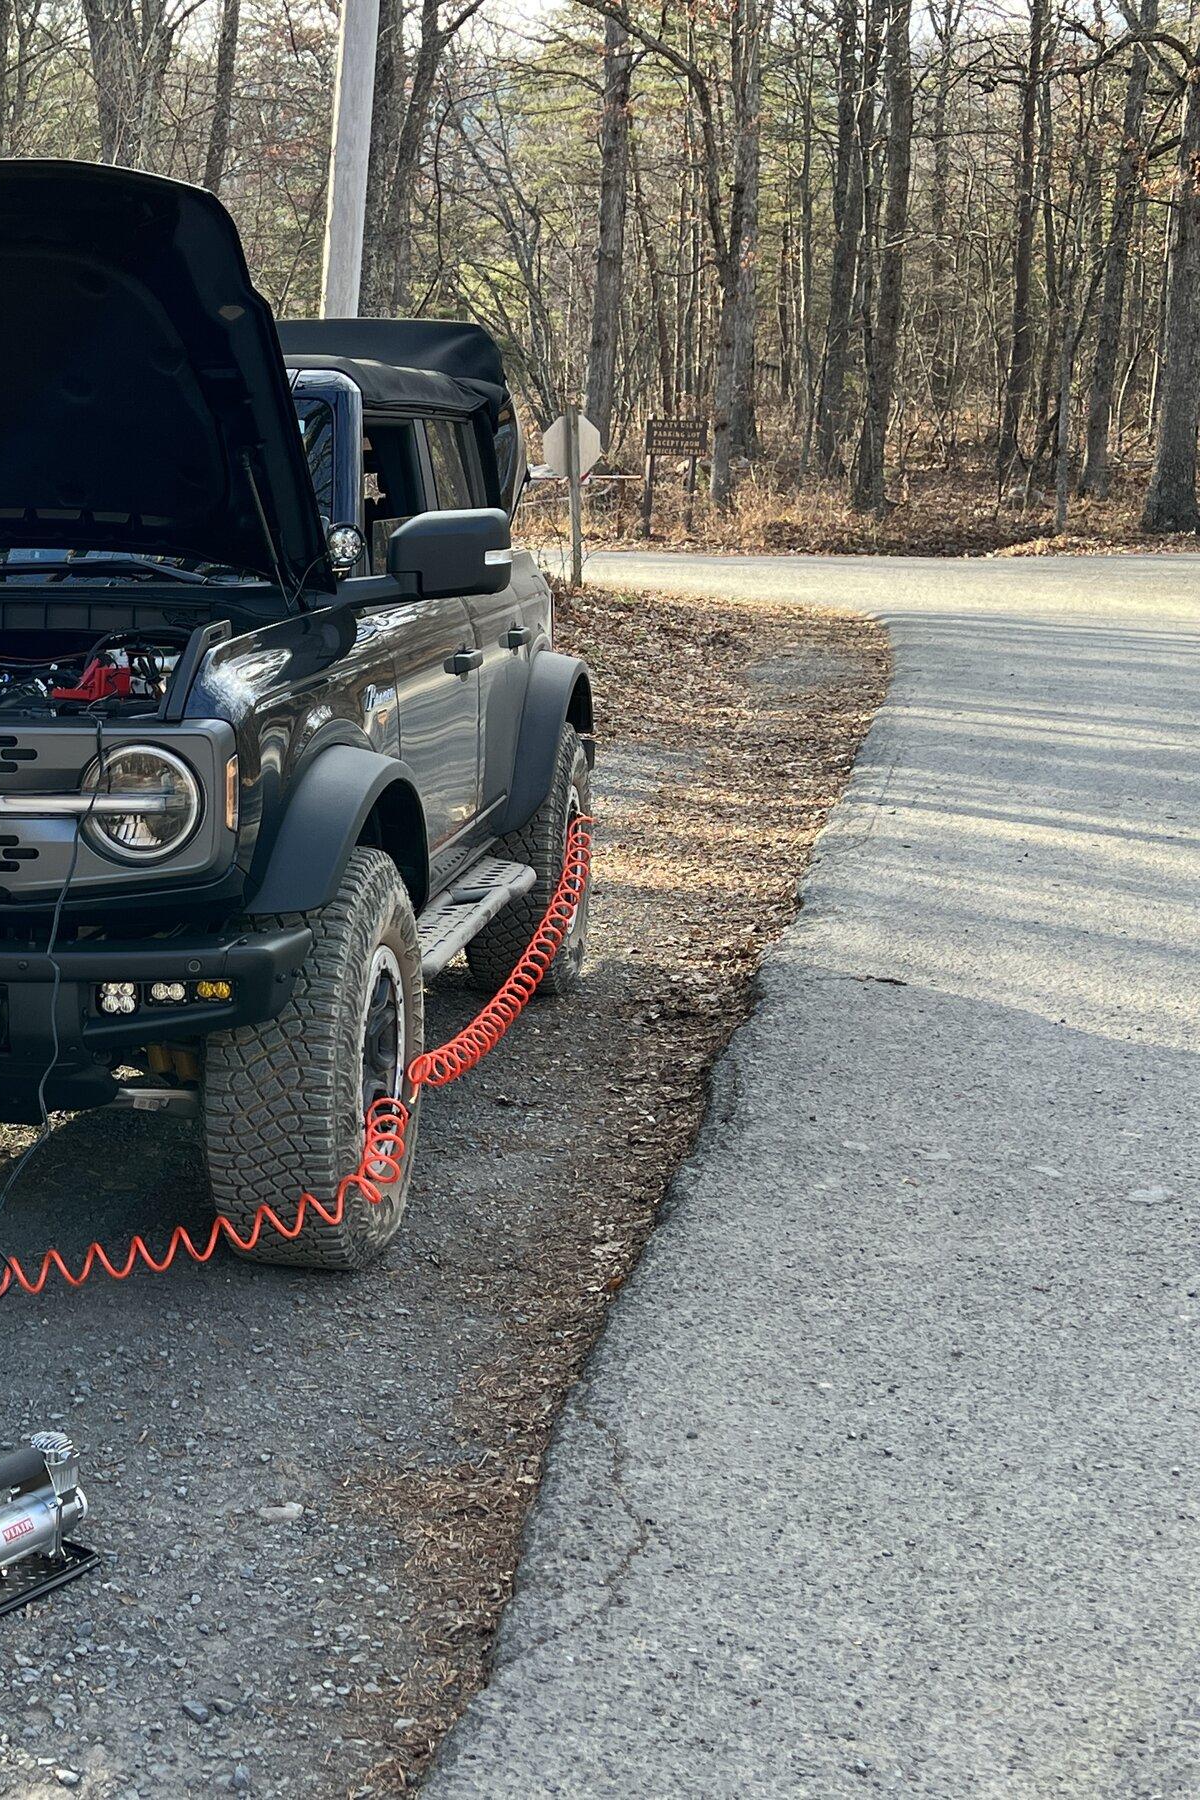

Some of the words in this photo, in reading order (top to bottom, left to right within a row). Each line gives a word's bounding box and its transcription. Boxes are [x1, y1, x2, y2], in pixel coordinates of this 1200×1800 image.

[664, 421, 678, 429] ATV
[653, 430, 685, 438] PARKING
[652, 439, 680, 447] EXCEPT
